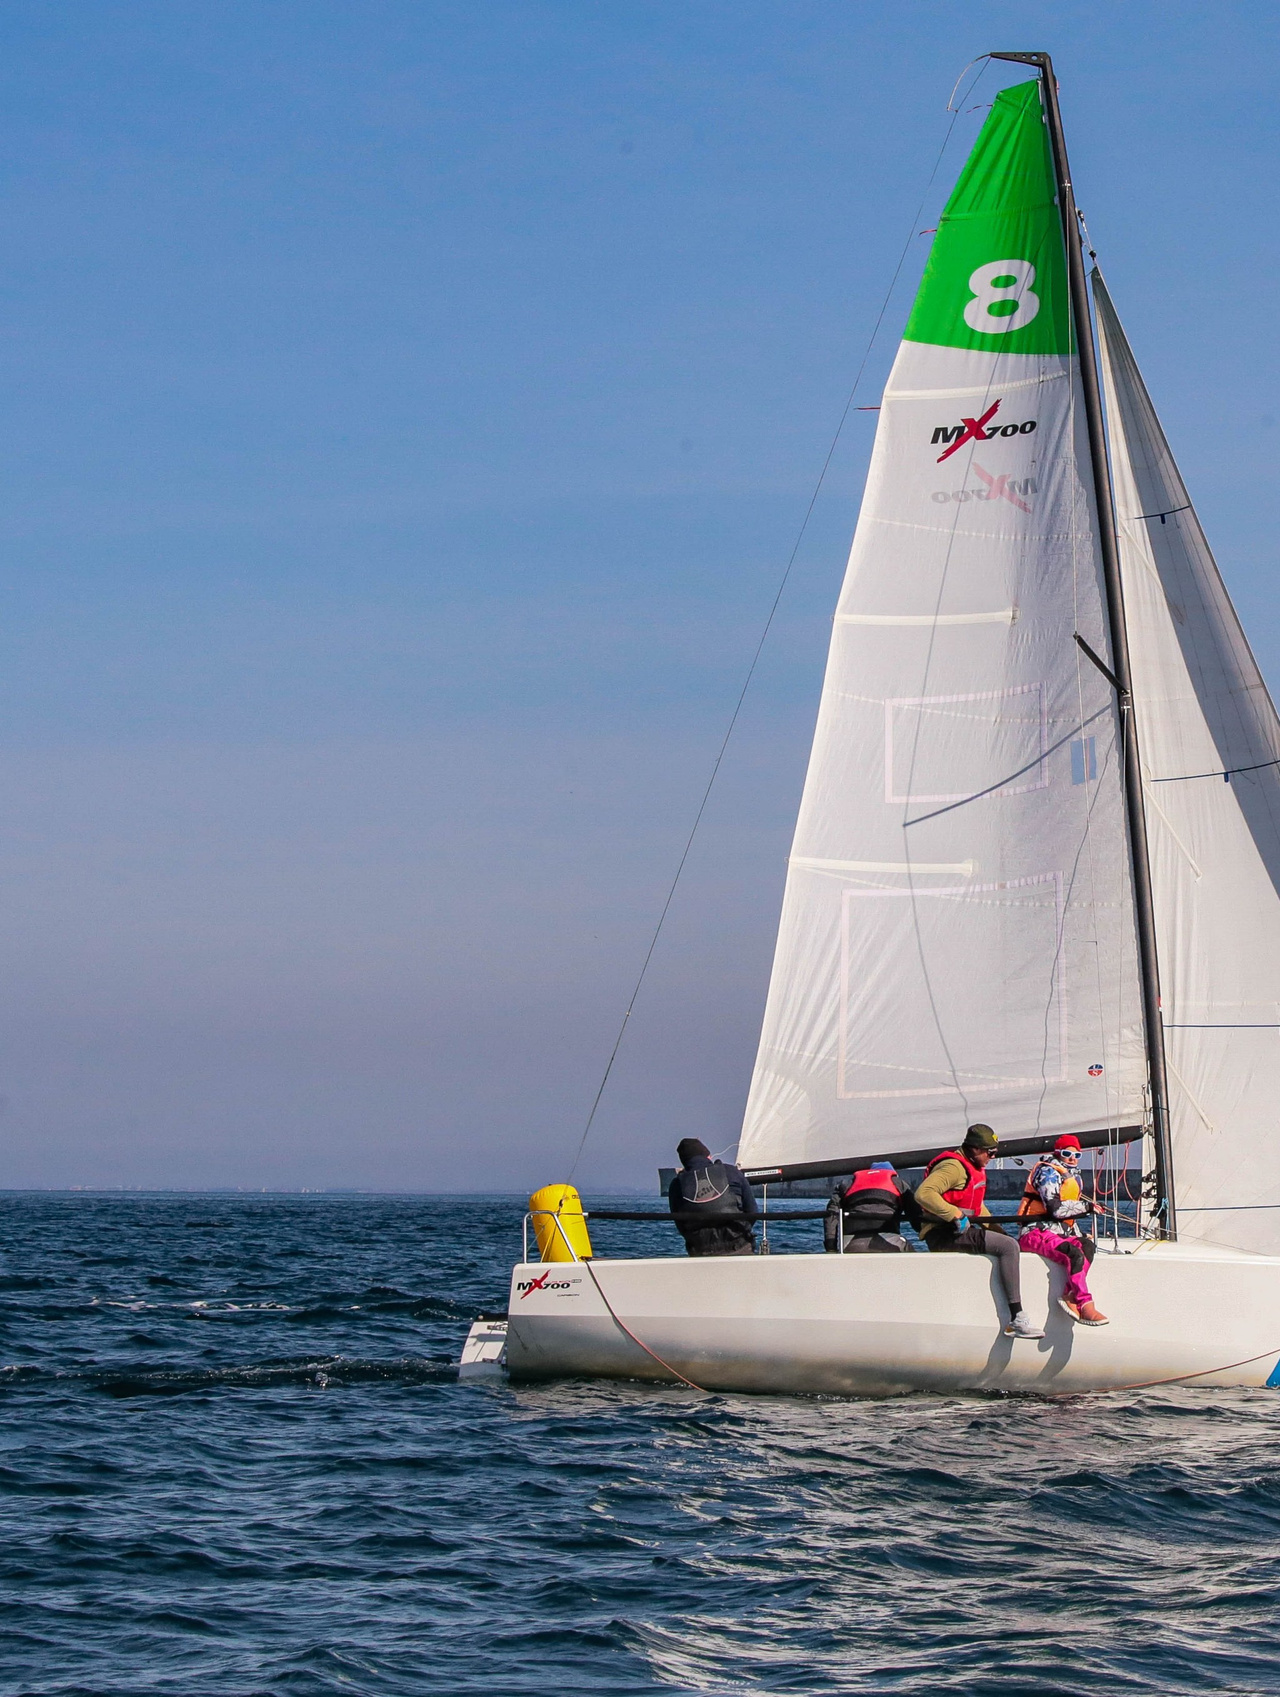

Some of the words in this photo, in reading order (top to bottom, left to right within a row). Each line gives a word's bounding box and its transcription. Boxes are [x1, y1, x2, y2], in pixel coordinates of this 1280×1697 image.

[963, 259, 1040, 334] 8
[930, 398, 1037, 463] MX700
[517, 1269, 571, 1300] MX700
